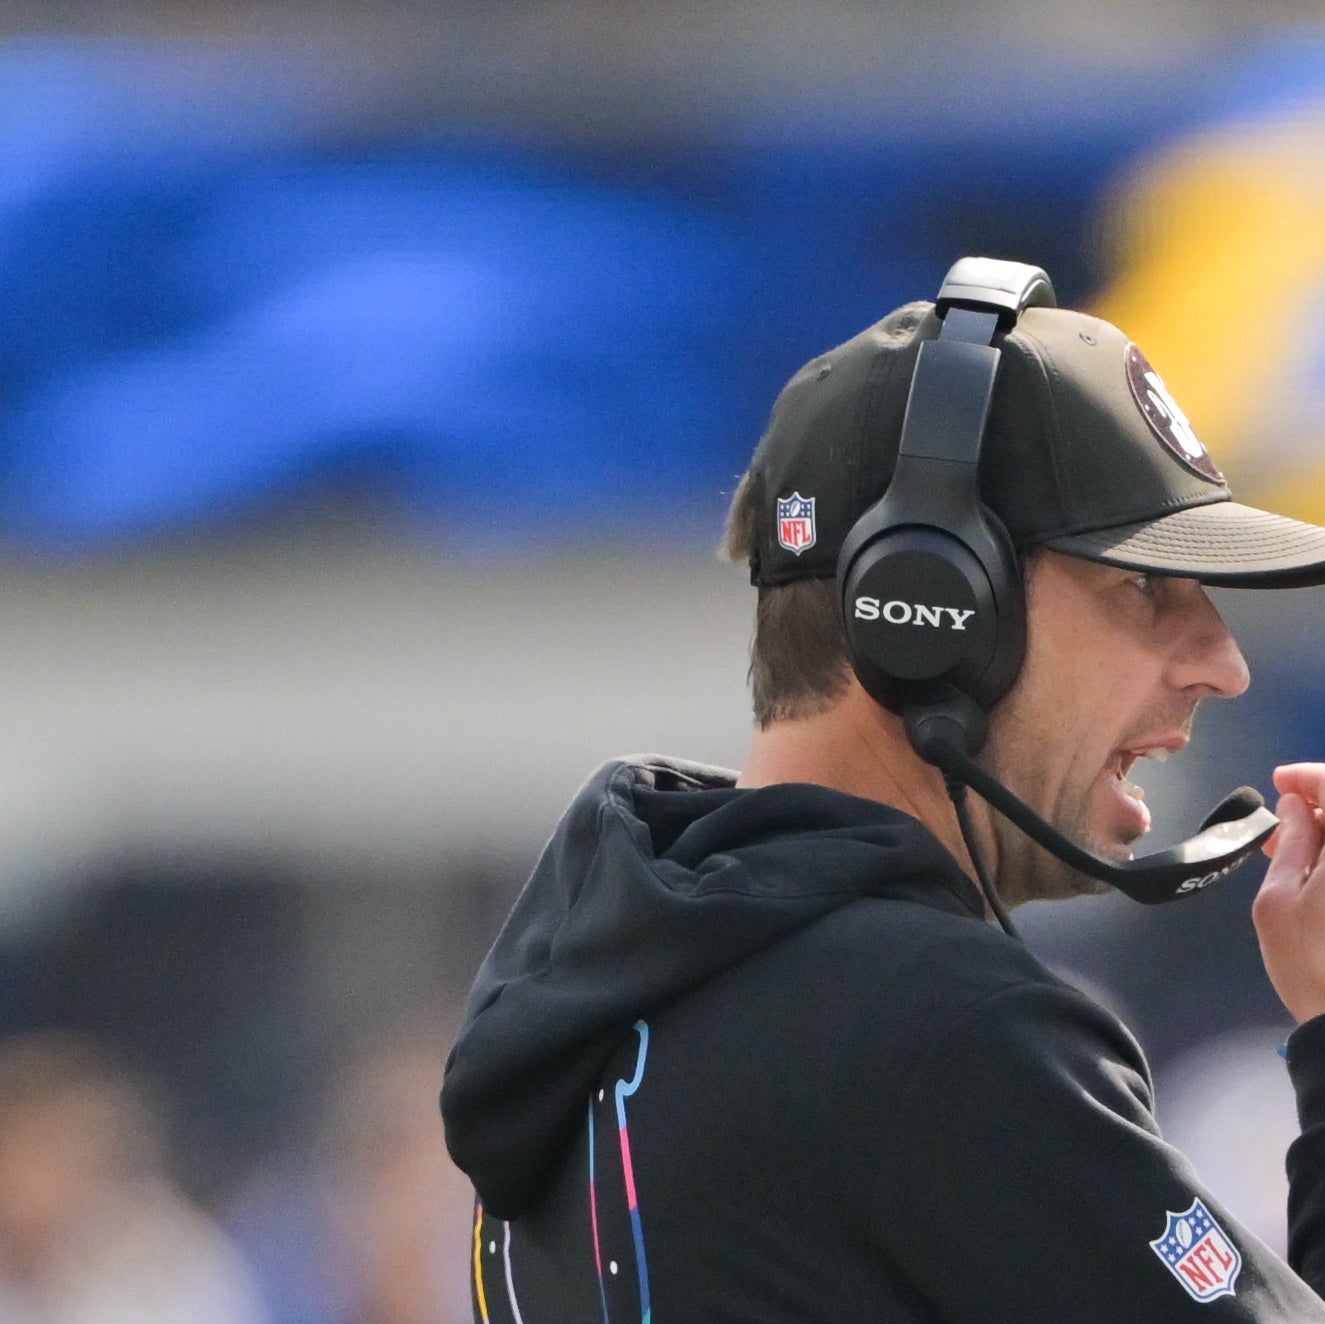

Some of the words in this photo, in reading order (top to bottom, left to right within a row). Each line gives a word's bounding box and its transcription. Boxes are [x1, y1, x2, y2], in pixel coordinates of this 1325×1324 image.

[781, 520, 812, 546] NFL
[854, 596, 976, 630] SONY
[1179, 1237, 1233, 1292] NFL
